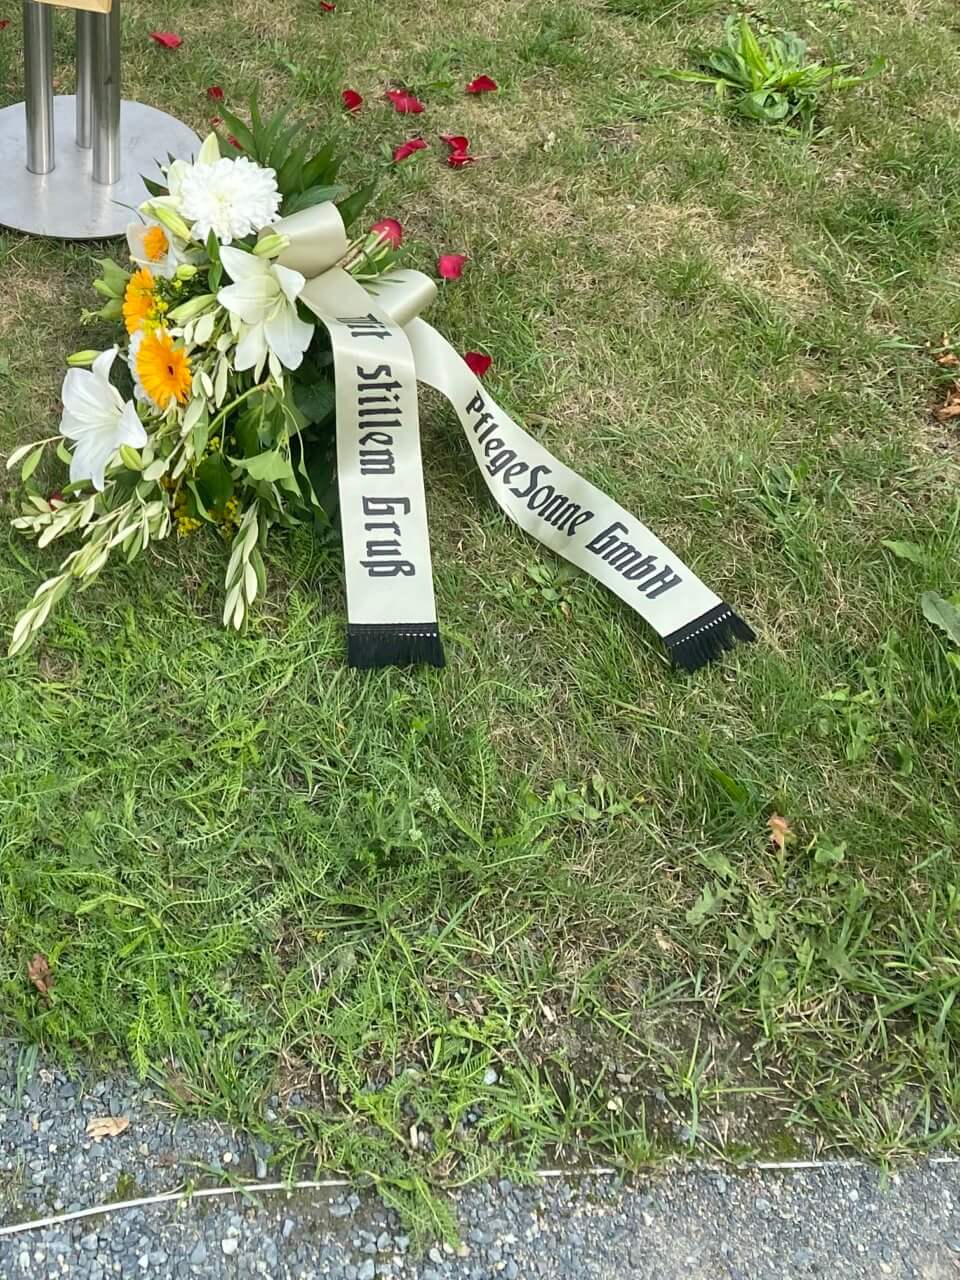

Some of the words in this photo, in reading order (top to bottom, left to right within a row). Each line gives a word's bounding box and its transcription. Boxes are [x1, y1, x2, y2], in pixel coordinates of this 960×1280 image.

[360, 496, 416, 578] Gruß
[465, 389, 595, 537] PflegeSonne
[585, 521, 683, 600] GmbH
